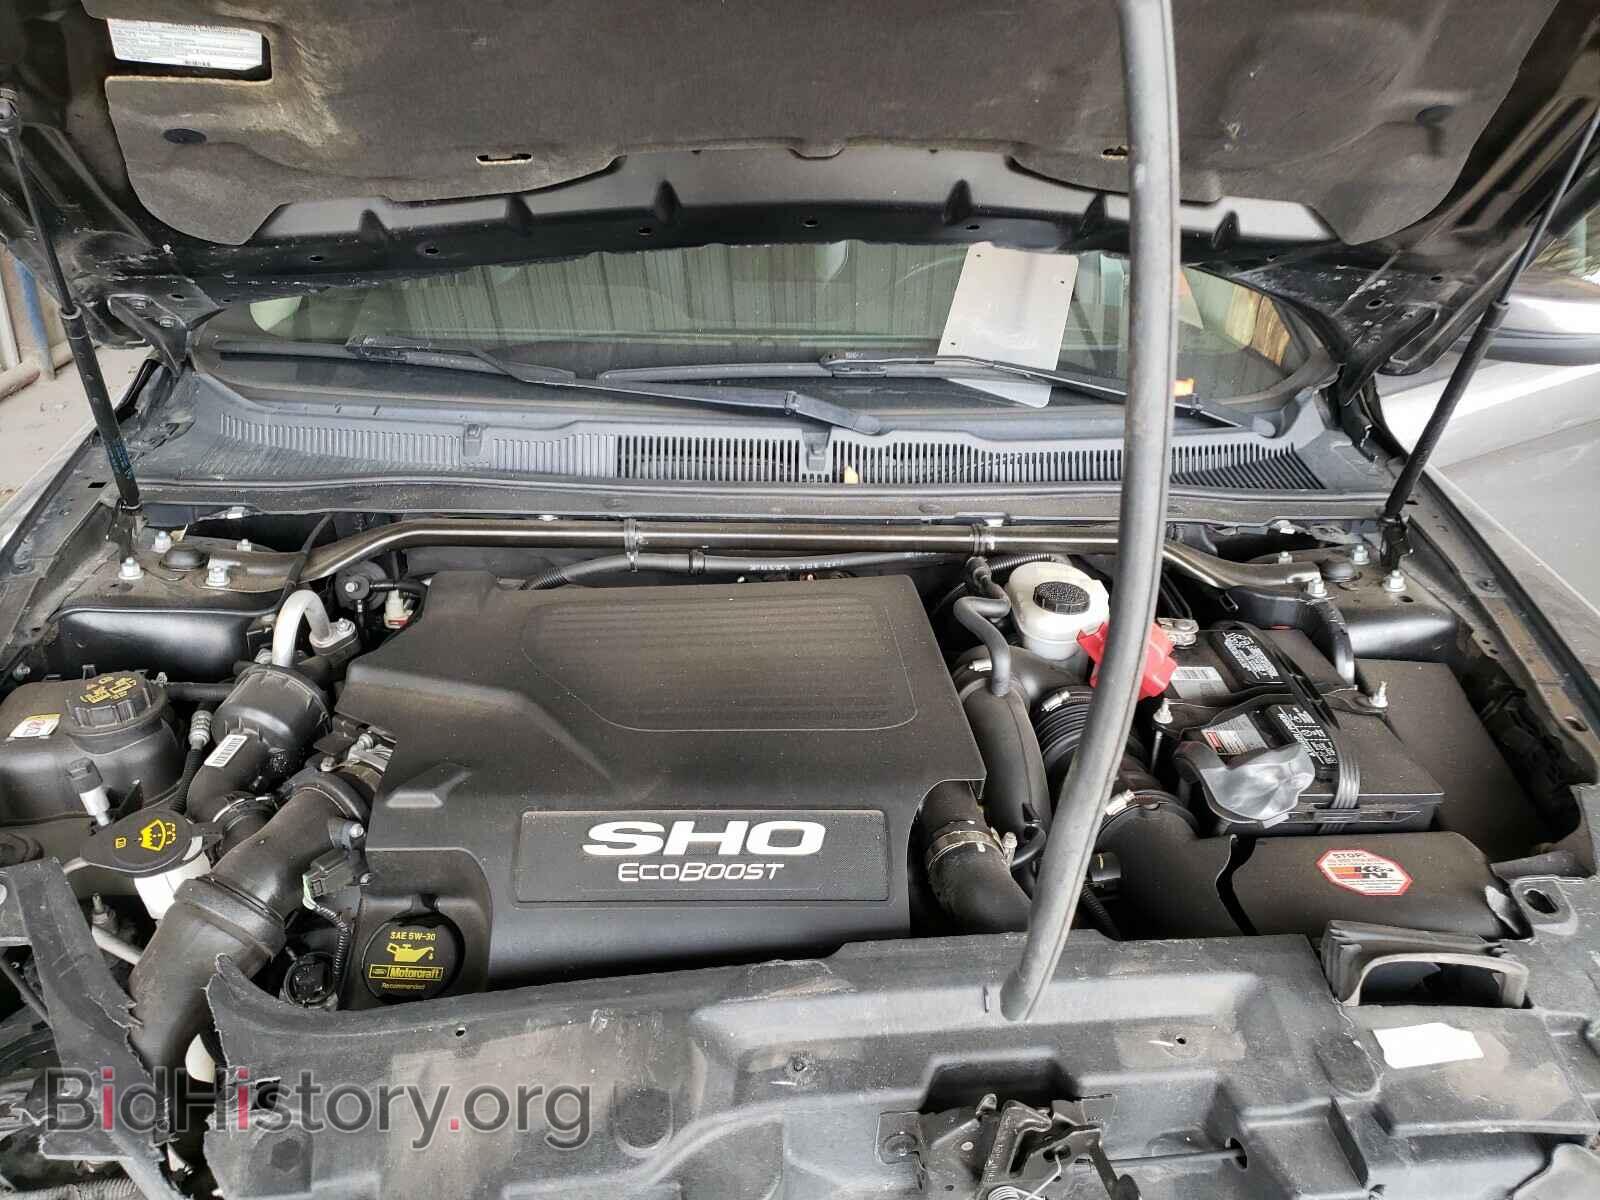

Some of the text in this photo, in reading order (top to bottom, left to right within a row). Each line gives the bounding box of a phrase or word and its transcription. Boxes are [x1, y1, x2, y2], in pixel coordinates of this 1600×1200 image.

[582, 820, 826, 856] SHO
[389, 931, 436, 941] SAE 5W-30
[390, 967, 441, 979] Motorcraft
